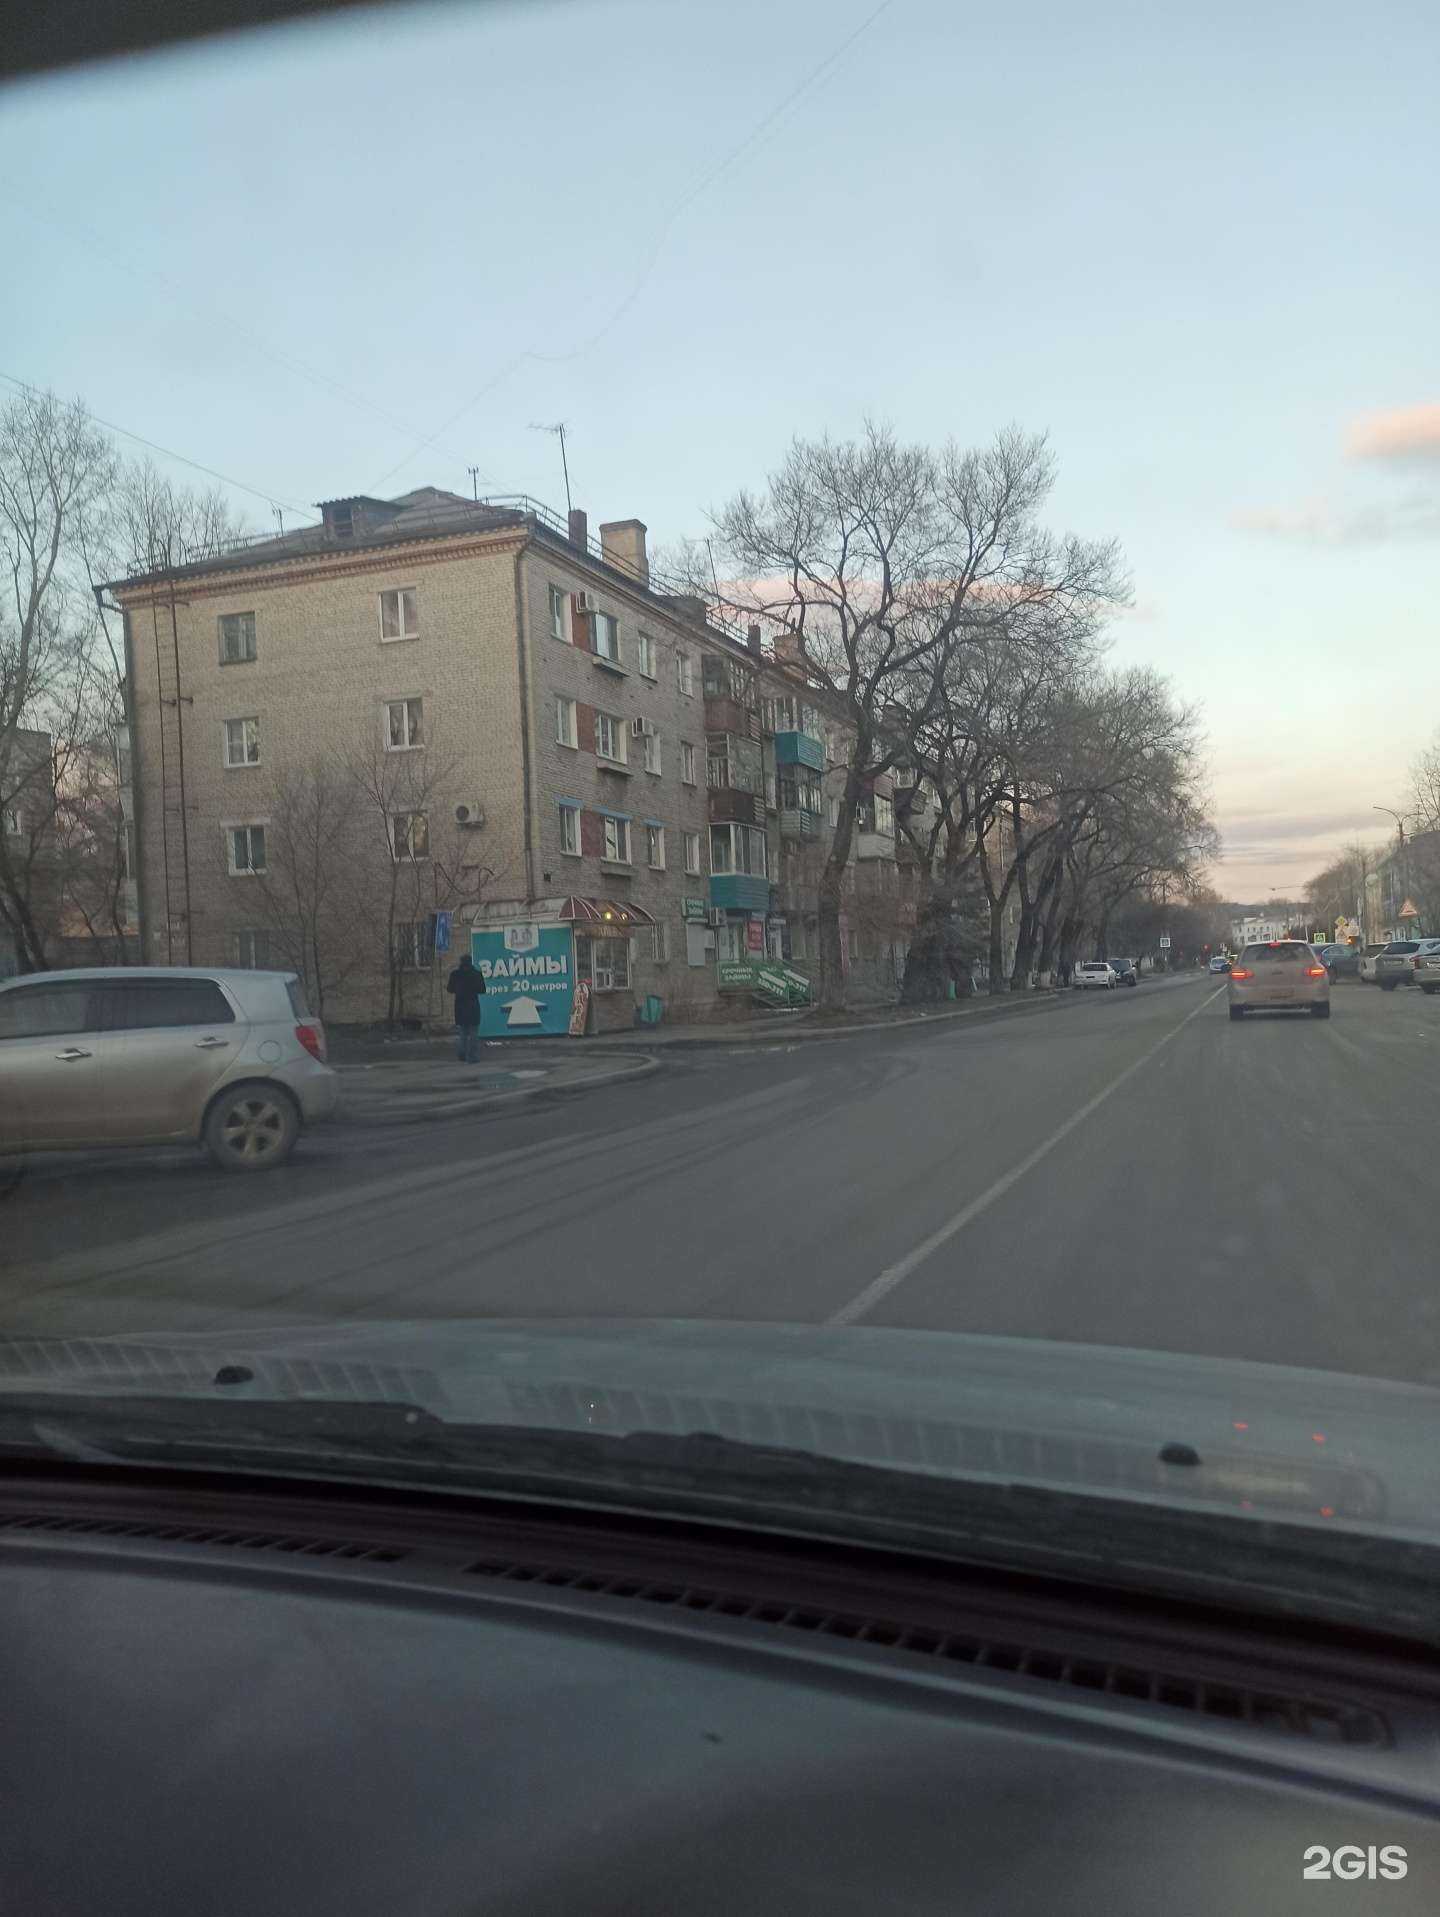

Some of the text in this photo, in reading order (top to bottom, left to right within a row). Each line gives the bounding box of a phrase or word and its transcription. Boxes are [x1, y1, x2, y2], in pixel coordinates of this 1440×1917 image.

[478, 954, 568, 978] ЗАЙМЫ
[511, 979, 530, 992] 20
[531, 981, 568, 994] метров
